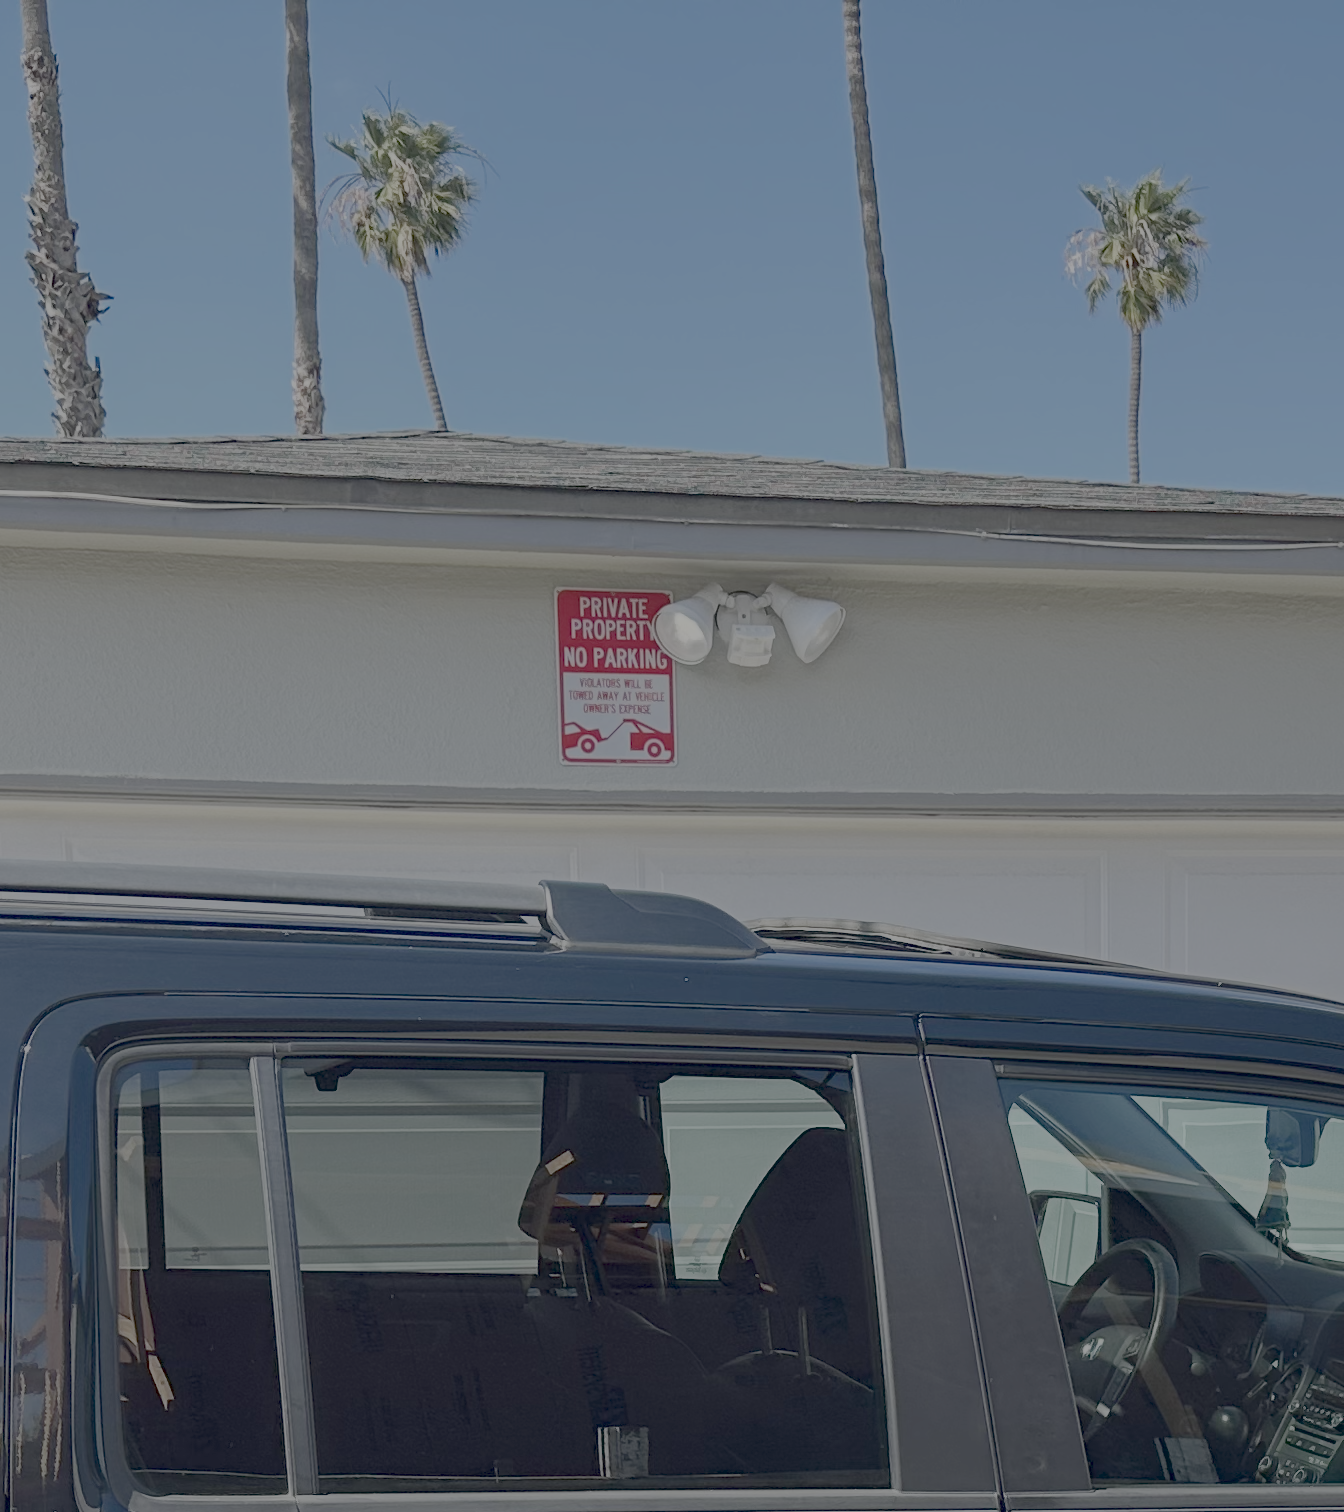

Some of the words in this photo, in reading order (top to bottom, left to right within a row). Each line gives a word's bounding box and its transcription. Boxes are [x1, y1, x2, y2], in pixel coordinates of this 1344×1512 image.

[580, 597, 648, 618] PRIVATE
[564, 647, 587, 667] NO
[594, 648, 667, 669] PARKING
[580, 678, 621, 688] VIOLATORS
[624, 679, 641, 688] WILL
[645, 680, 653, 689] BE
[569, 691, 593, 700] TOWED
[597, 691, 619, 701] AWAY
[623, 692, 632, 701] AT
[635, 692, 665, 702] VEHICLE
[583, 704, 616, 714] OWNER'S
[619, 705, 651, 714] EXPENSE
